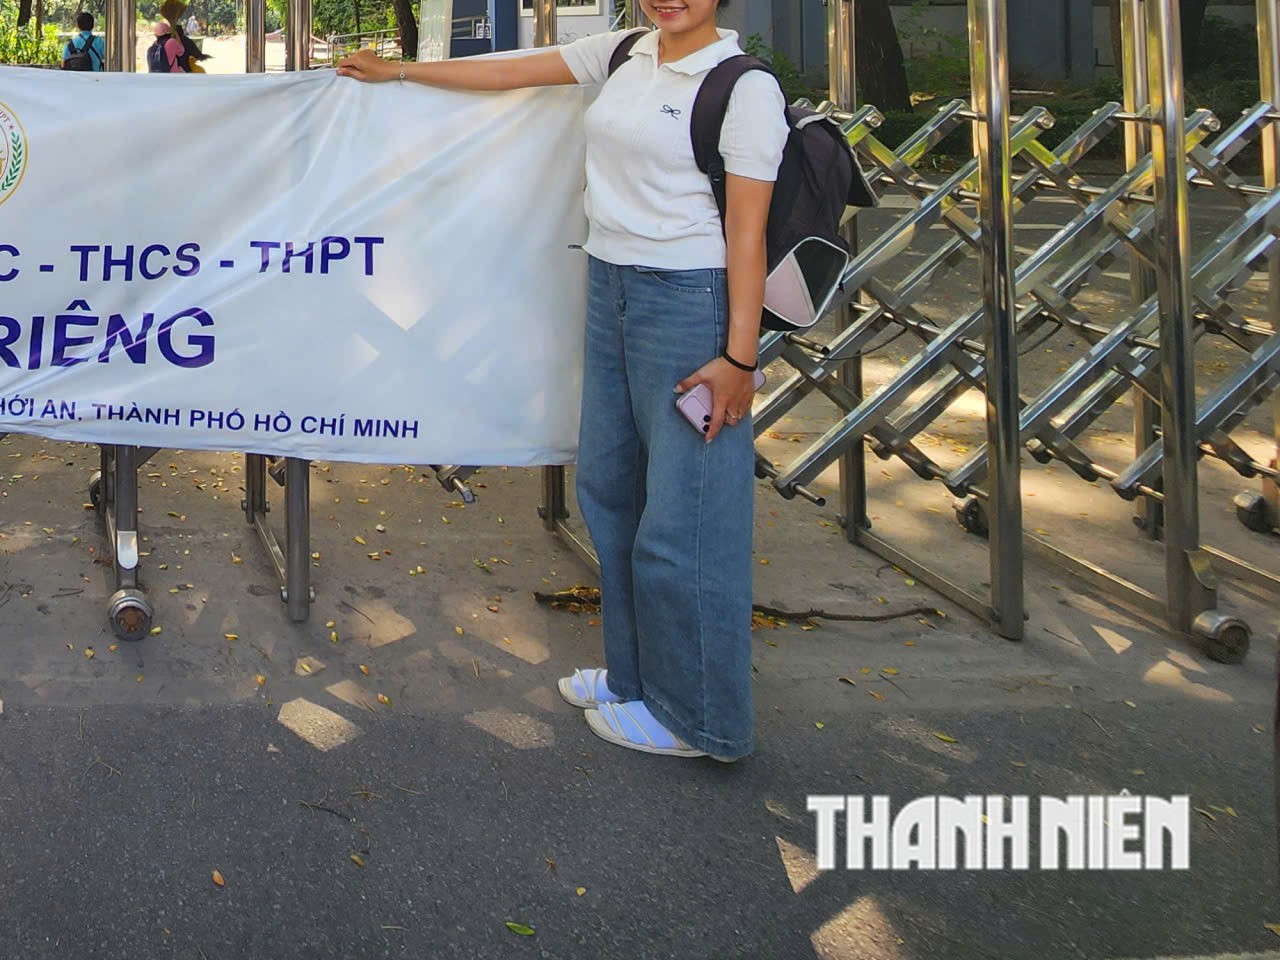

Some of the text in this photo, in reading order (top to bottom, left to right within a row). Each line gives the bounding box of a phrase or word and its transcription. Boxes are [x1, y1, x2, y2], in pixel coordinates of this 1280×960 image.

[70, 242, 202, 282] THCS
[250, 236, 385, 276] THPT
[91, 401, 181, 426] THÀNH
[189, 407, 246, 432] PHỐ
[253, 410, 293, 433] HỒ
[300, 413, 345, 436] CHÍ
[353, 418, 420, 439] MINH
